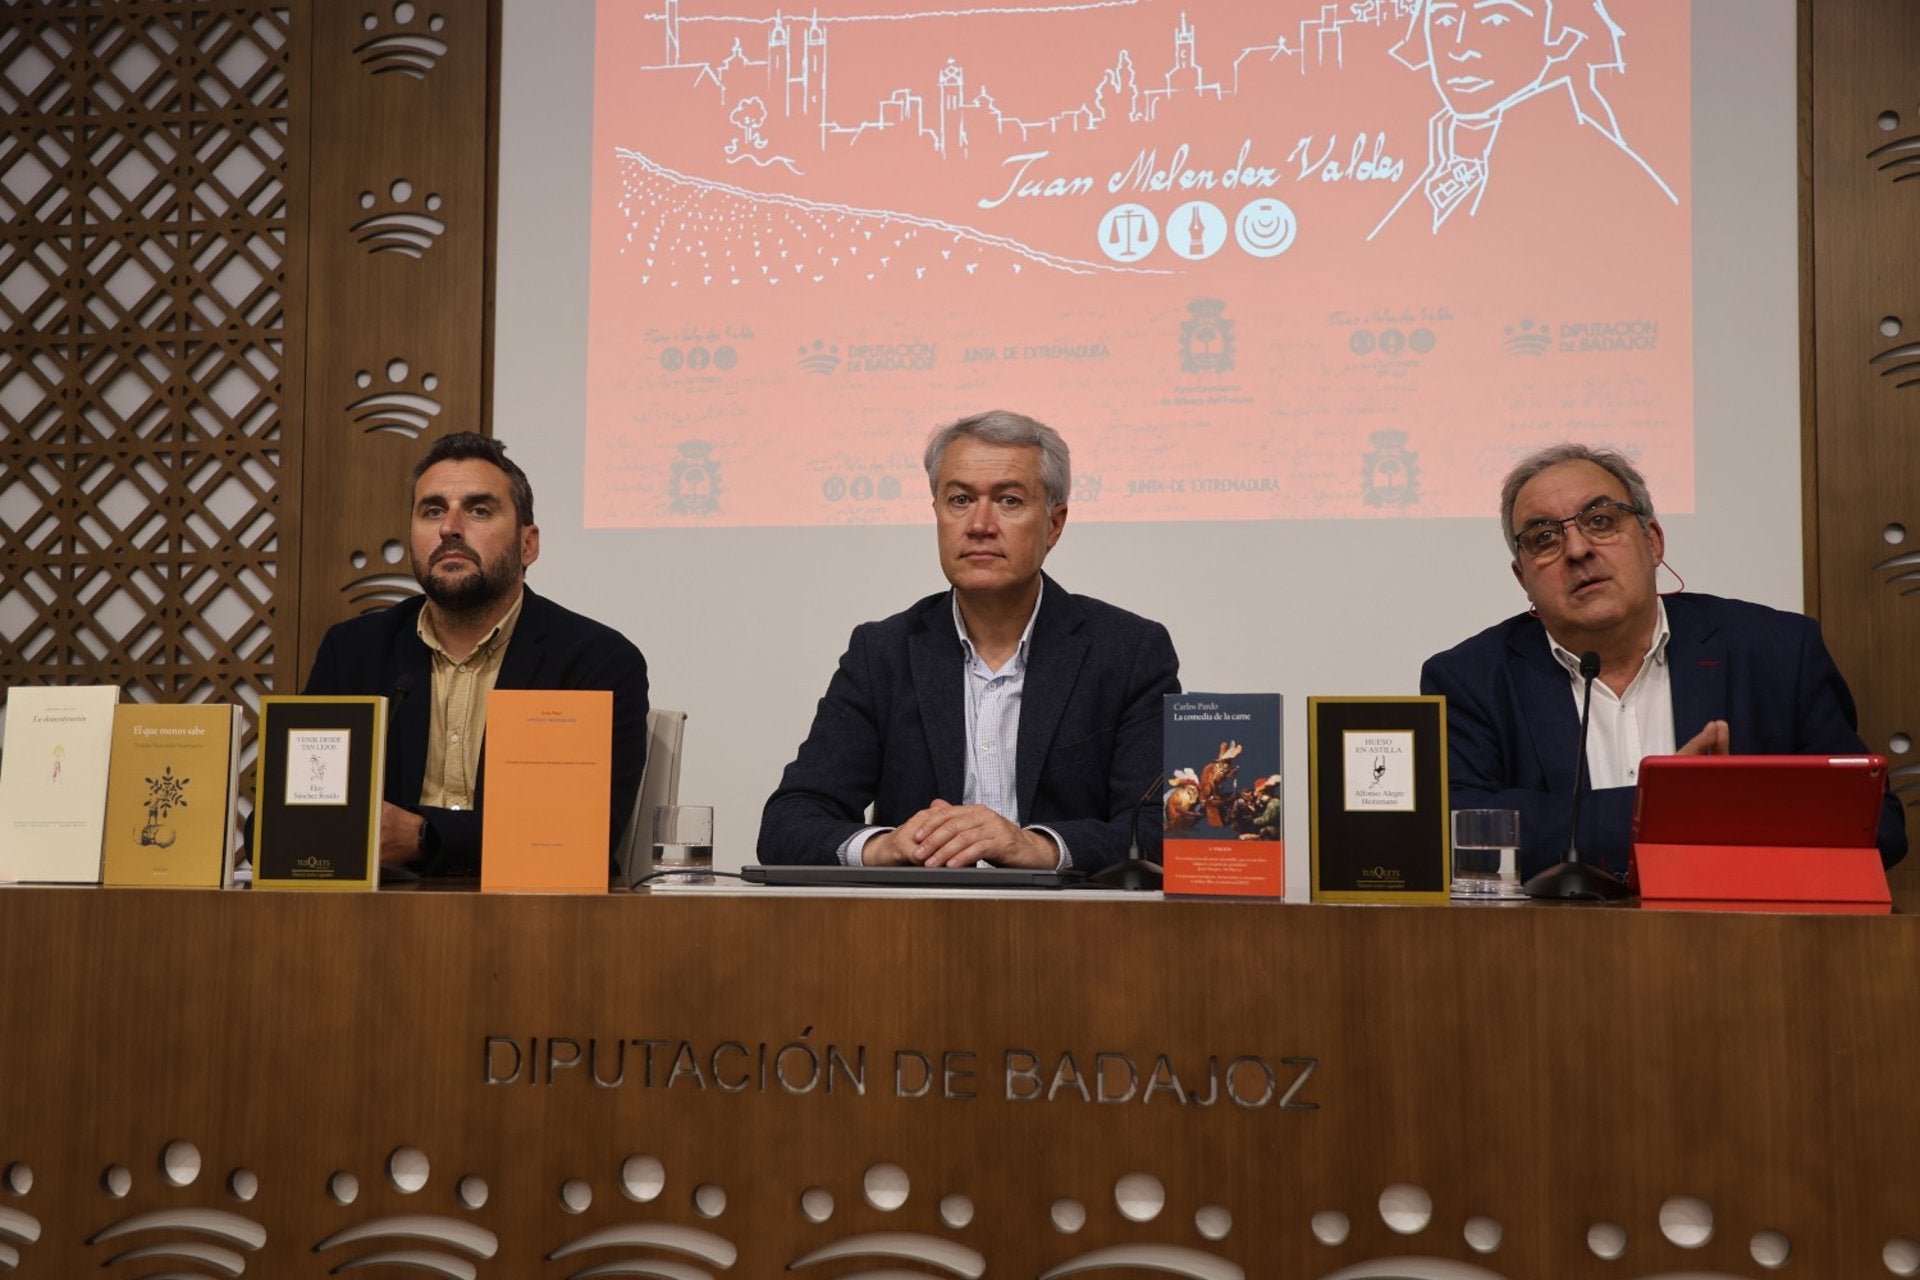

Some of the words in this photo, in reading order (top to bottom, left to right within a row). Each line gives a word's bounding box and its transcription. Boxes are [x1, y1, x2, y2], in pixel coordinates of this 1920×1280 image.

[978, 150, 1094, 208] Juan
[1560, 340, 1576, 352] DE
[962, 347, 998, 362] JUNTA
[1003, 346, 1018, 360] DE
[848, 361, 862, 373] DE
[1127, 479, 1164, 495] JUNTA
[1170, 479, 1186, 494] DE
[1173, 702, 1196, 711] Carlos
[1198, 702, 1218, 711] Pardo
[1174, 713, 1183, 721] La
[1184, 713, 1213, 721] comedia
[133, 725, 142, 735] El
[142, 729, 159, 737] que
[188, 726, 206, 735] sabe
[316, 744, 337, 752] LEJOS
[1365, 738, 1393, 746] HUESO
[1356, 746, 1367, 754] EN
[1369, 746, 1402, 754] ASTILLA
[485, 1025, 867, 1096] DIPUTACIÓN
[894, 1049, 977, 1099] DE
[1004, 1048, 1320, 1109] BADAJOZ
